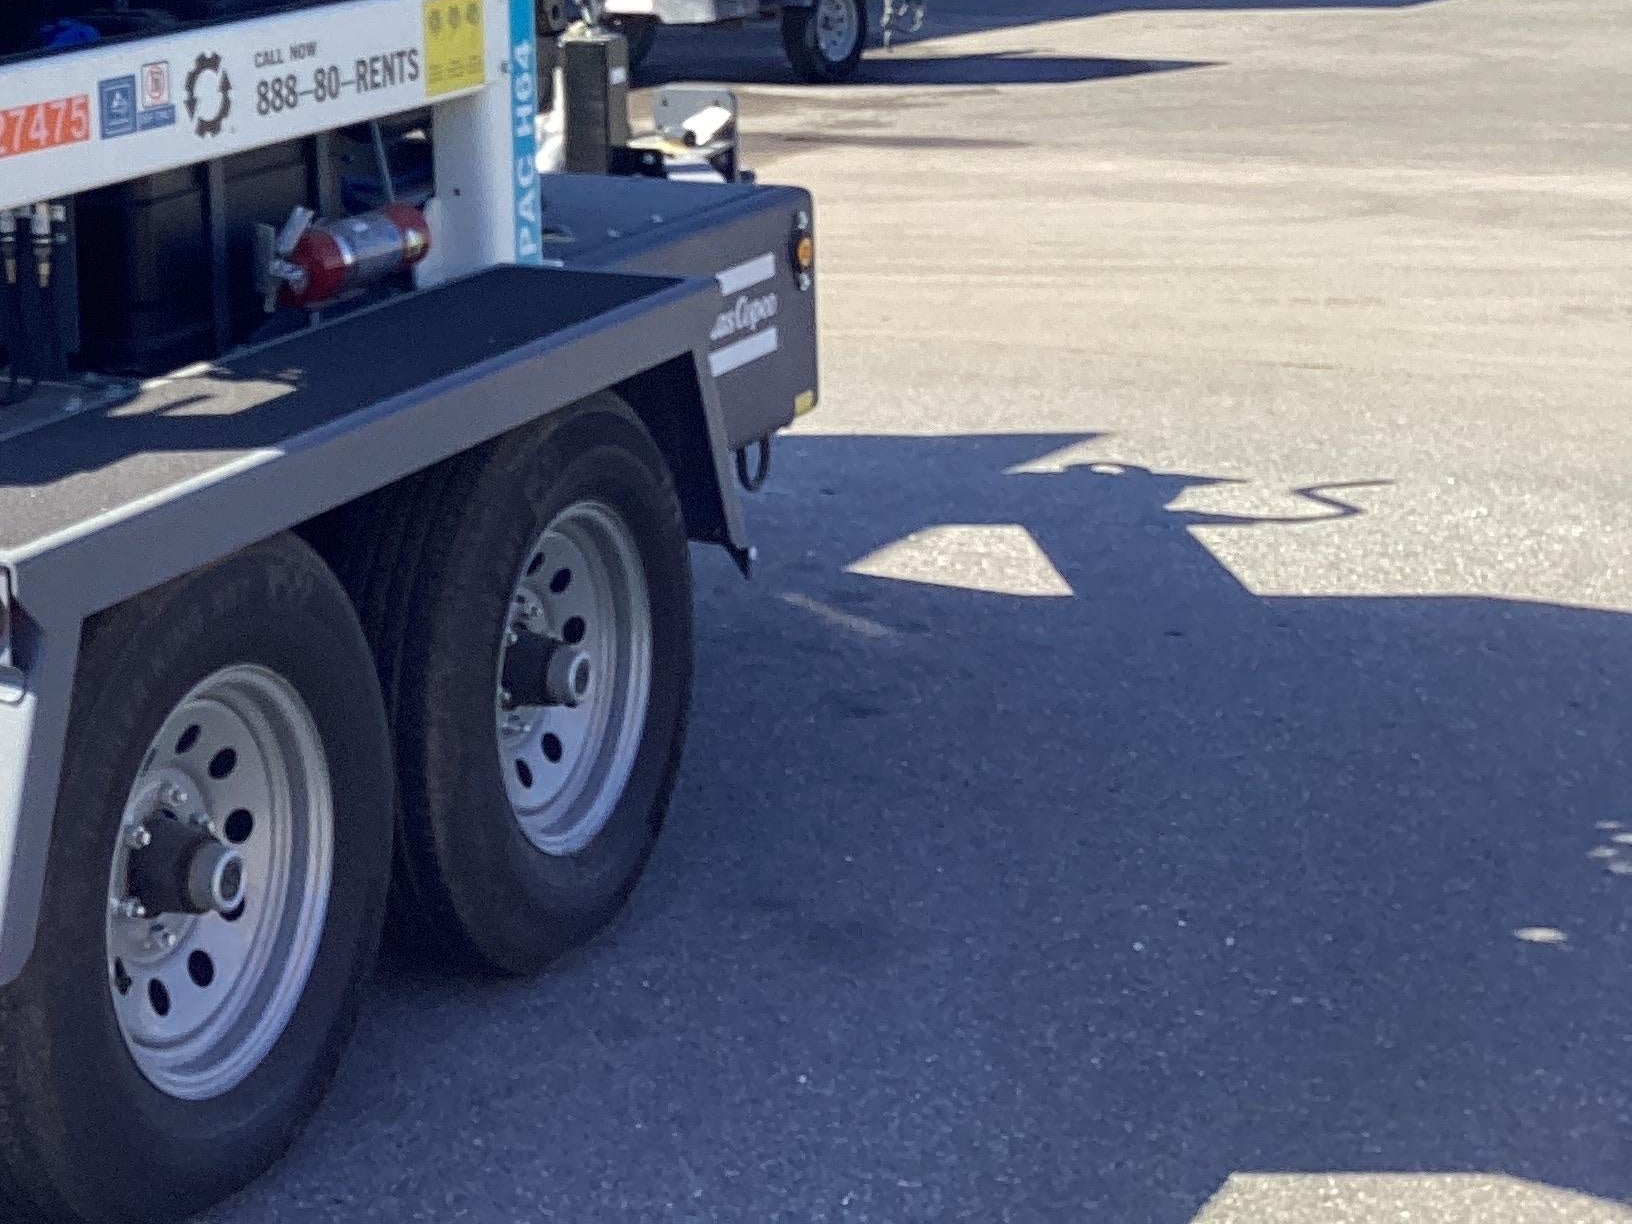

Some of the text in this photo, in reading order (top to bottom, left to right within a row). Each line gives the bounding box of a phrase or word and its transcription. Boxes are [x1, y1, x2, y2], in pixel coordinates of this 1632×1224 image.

[255, 42, 318, 68] CALL NOW
[256, 48, 419, 116] 888-80-RENTS
[518, 154, 536, 257] PAC
